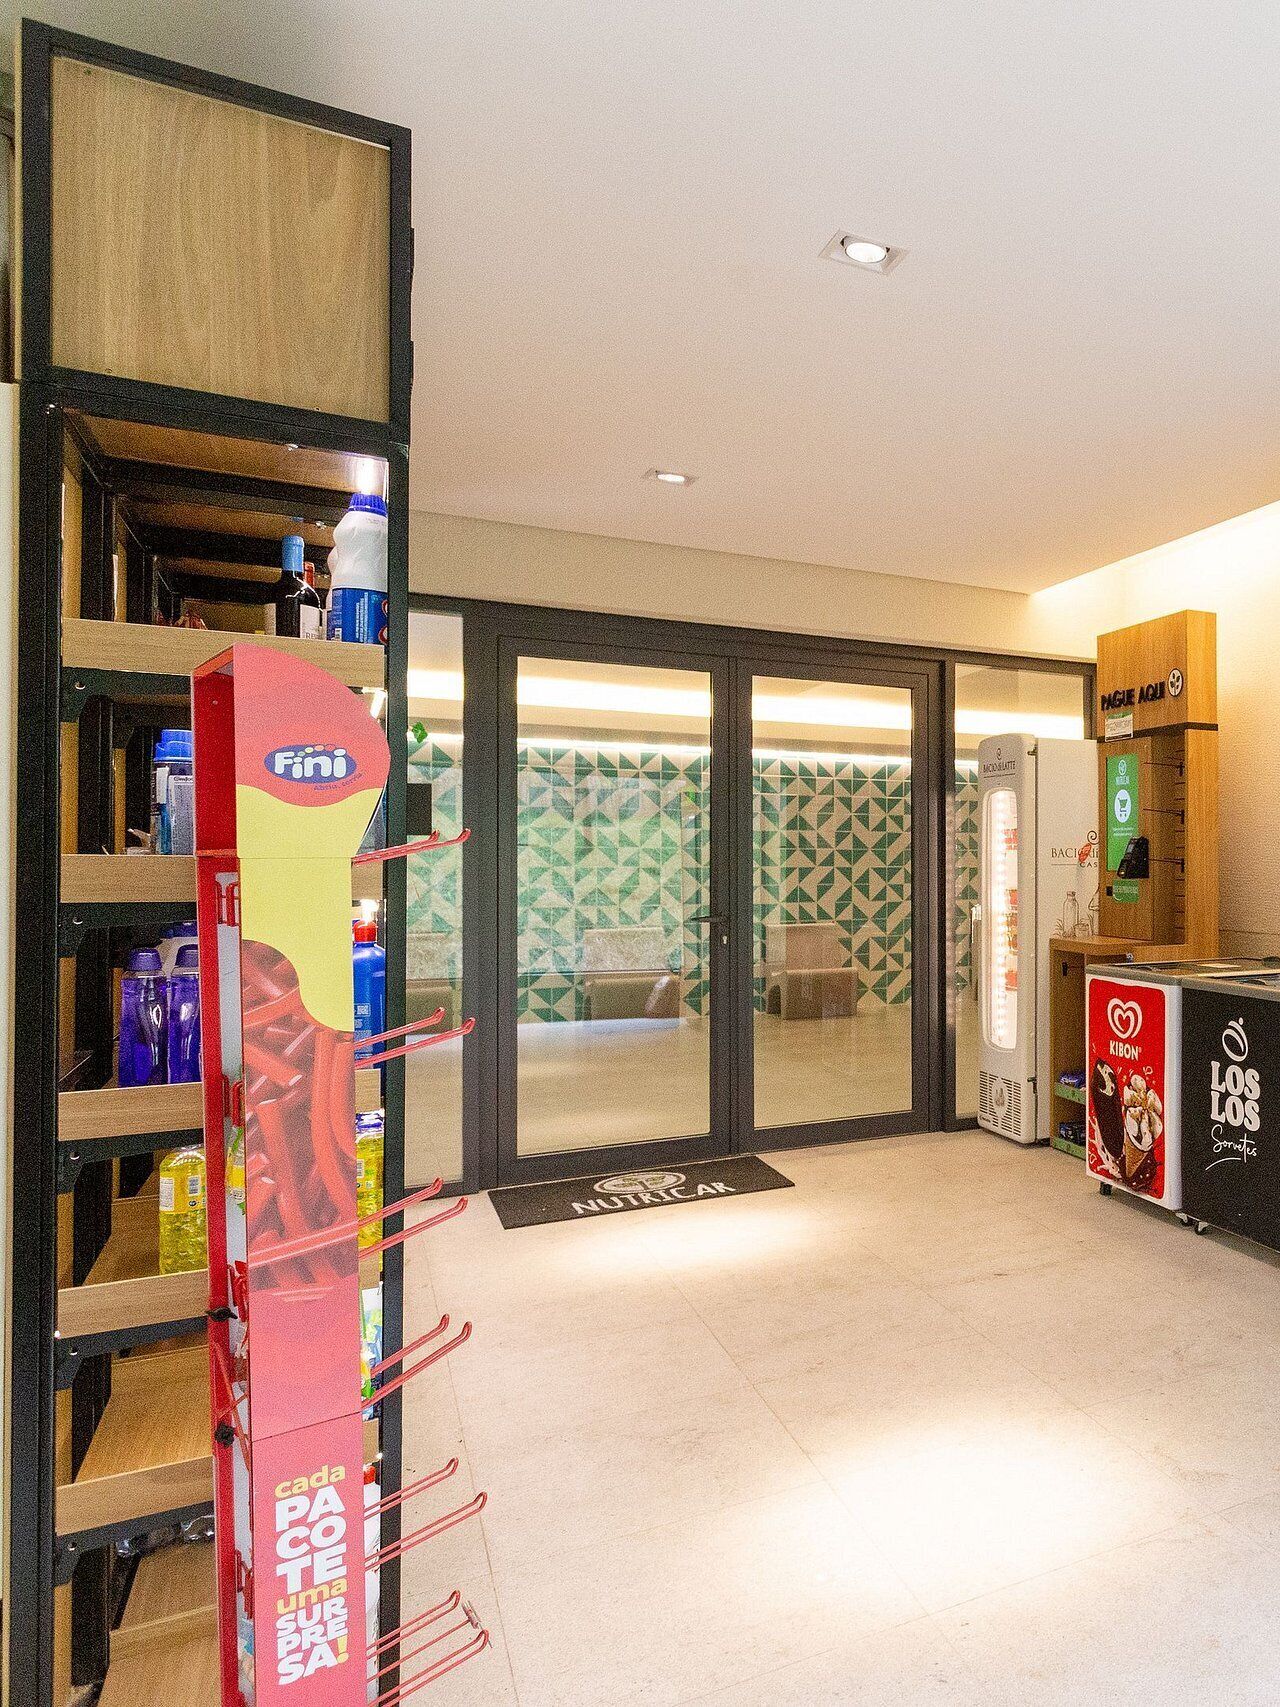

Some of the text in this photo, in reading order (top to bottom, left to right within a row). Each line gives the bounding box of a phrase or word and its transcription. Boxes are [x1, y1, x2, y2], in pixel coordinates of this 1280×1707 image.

[1101, 681, 1165, 711] PAGUE AQUI
[274, 748, 347, 779] Fini
[1003, 760, 1016, 771] LATTE
[1110, 1040, 1139, 1061] KIBON
[1211, 1060, 1261, 1100] LOS
[1211, 1090, 1261, 1132] LOS
[1211, 1124, 1257, 1163] Sorvetes
[571, 1182, 737, 1214] NUTRICAR
[274, 1464, 346, 1499] cada
[275, 1485, 346, 1532] PA
[276, 1515, 347, 1559] CO
[276, 1542, 347, 1595] TE
[277, 1577, 348, 1614] uma
[275, 1596, 348, 1638] SUR
[277, 1614, 348, 1659] PRE
